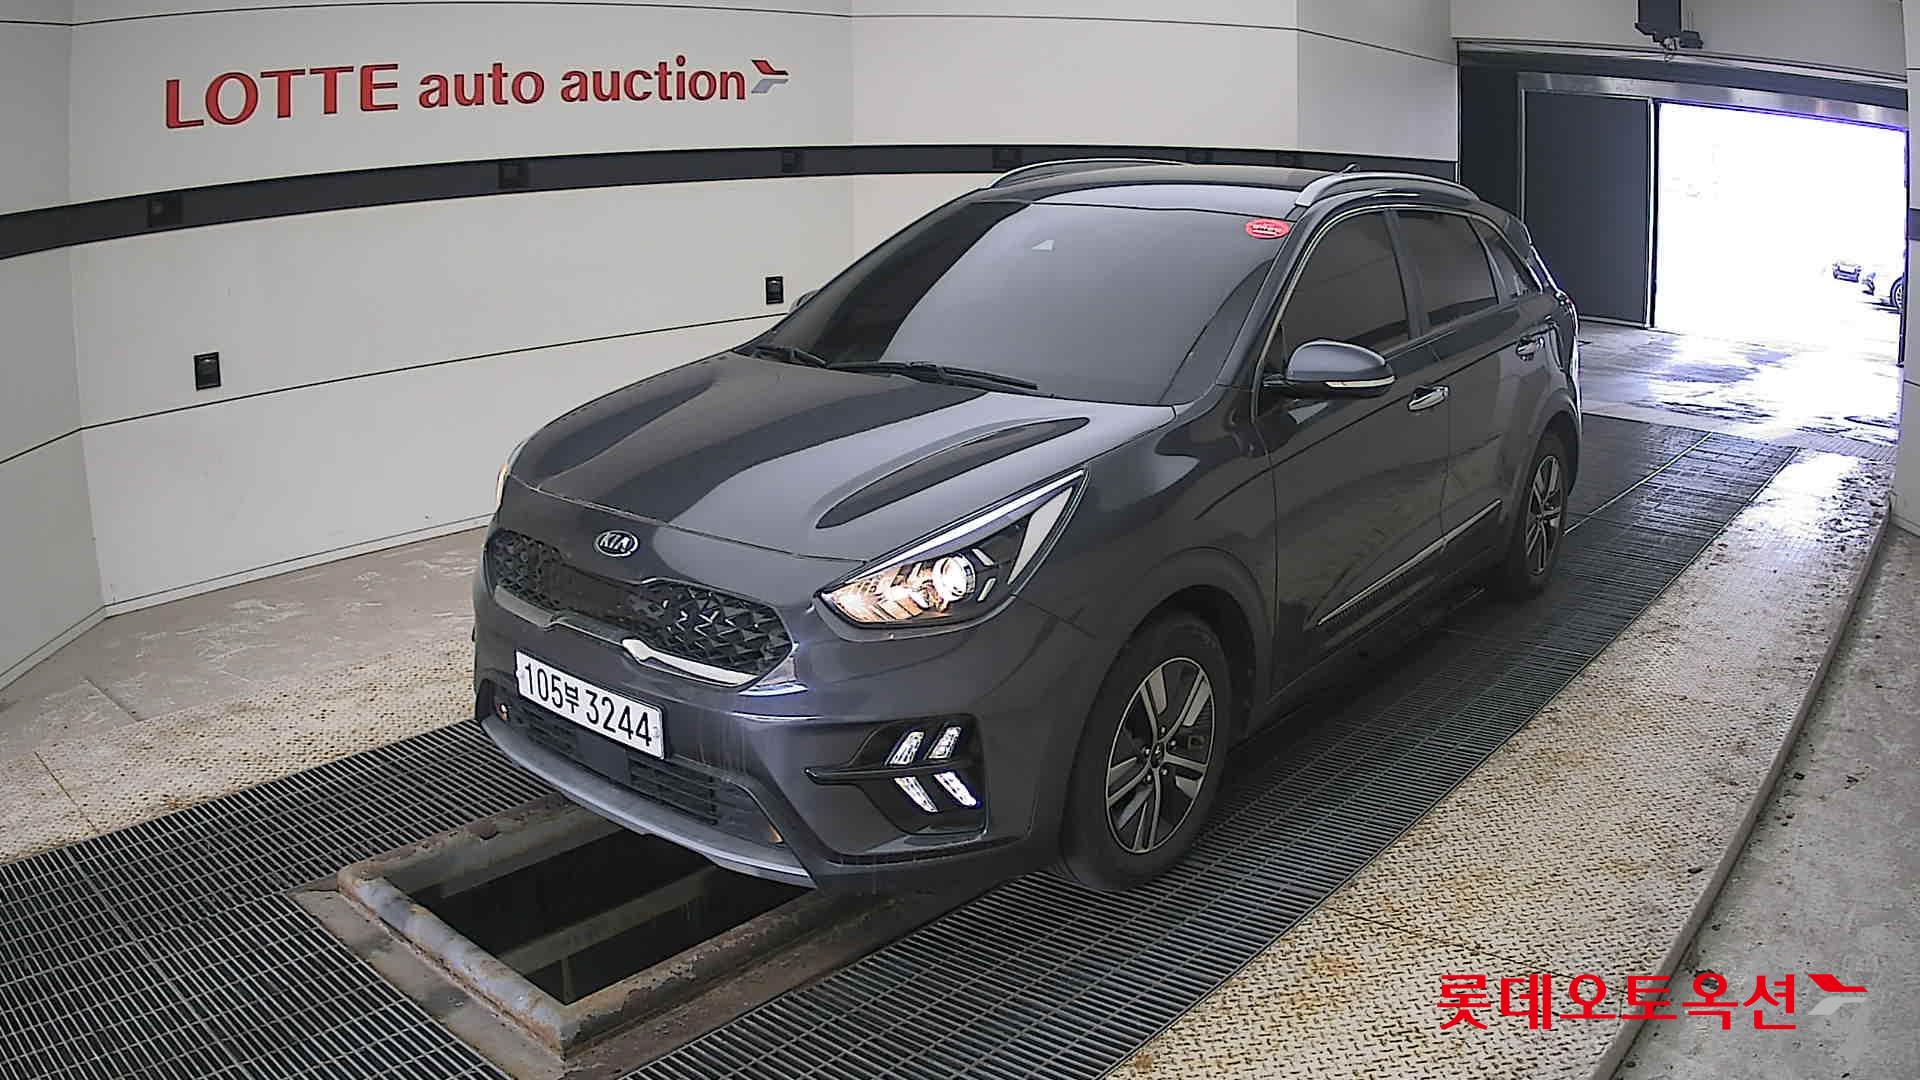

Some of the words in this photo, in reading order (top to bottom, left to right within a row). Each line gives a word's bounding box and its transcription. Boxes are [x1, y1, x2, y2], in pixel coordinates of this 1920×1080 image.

[166, 63, 399, 129] LOTTE
[418, 62, 546, 108] auto
[560, 55, 746, 103] auction
[598, 531, 631, 552] KIA
